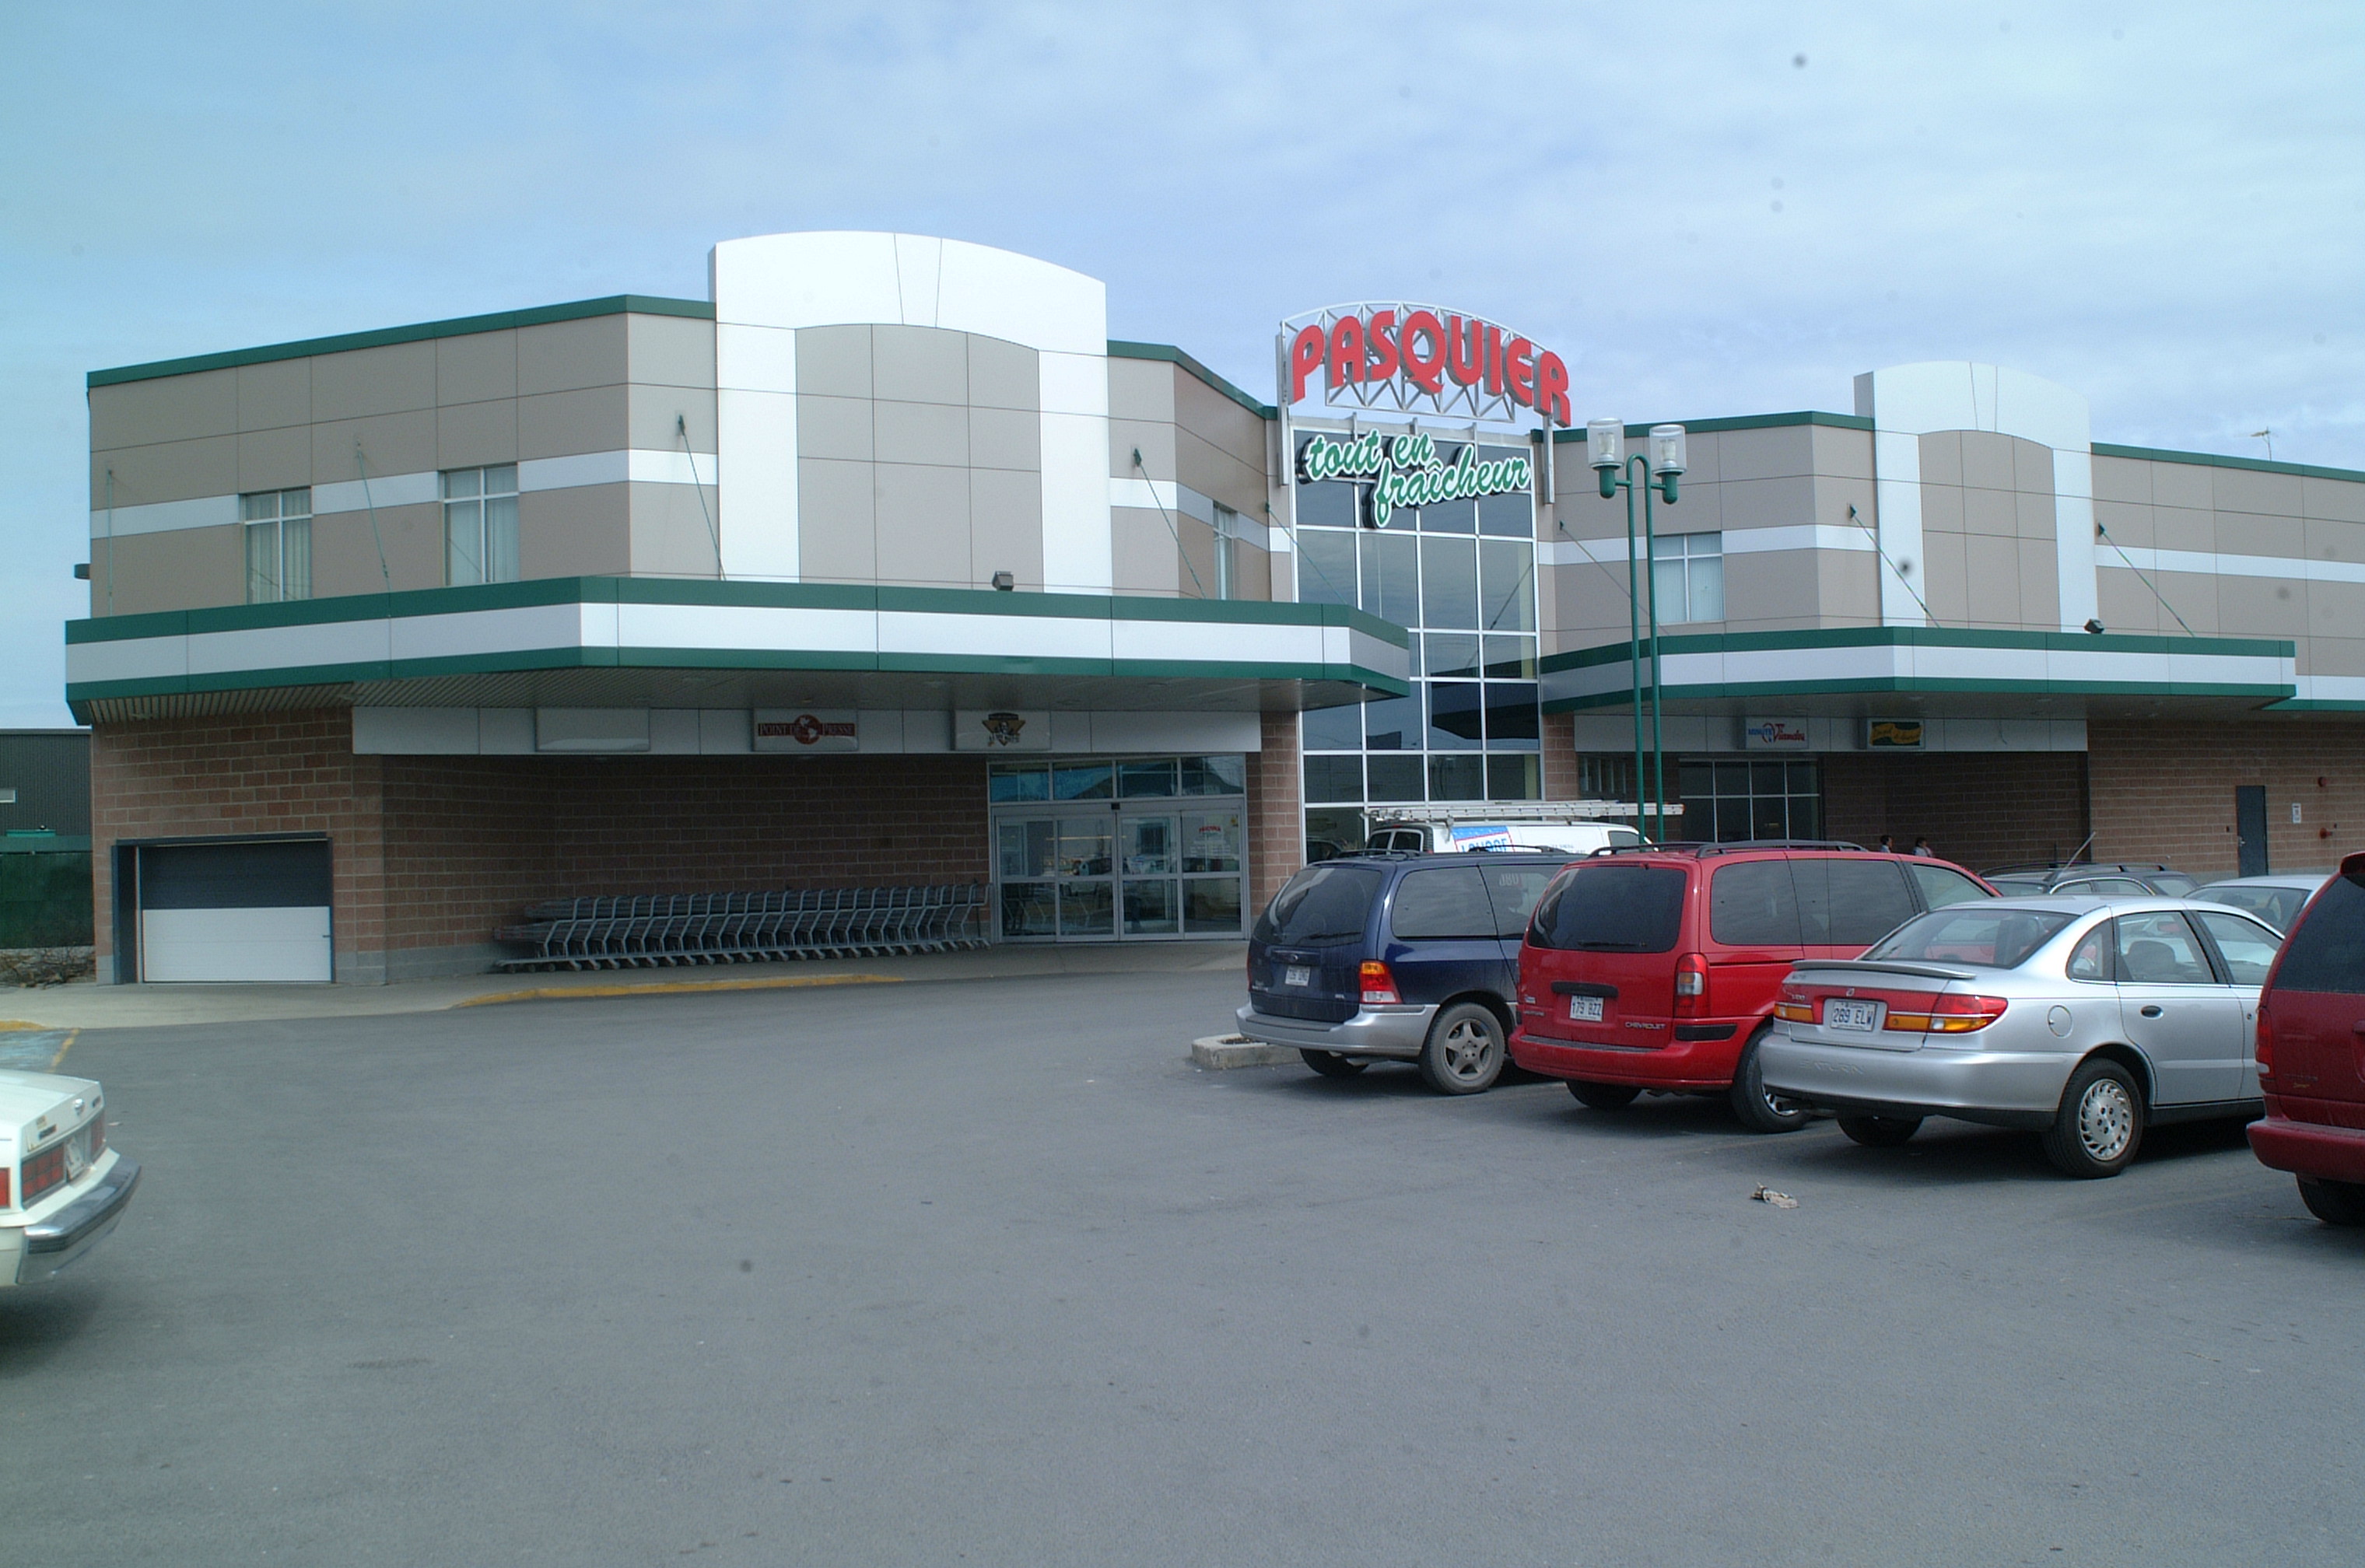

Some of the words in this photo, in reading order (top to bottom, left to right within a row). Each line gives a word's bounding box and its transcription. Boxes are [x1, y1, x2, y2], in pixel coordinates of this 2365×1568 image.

[1289, 310, 1571, 427] PASQUIER
[1303, 429, 1382, 481] tout
[1392, 431, 1436, 468] en
[1375, 443, 1530, 527] fraîcheur
[760, 724, 786, 736] POINT
[1625, 1021, 1666, 1030] CHEVROLET
